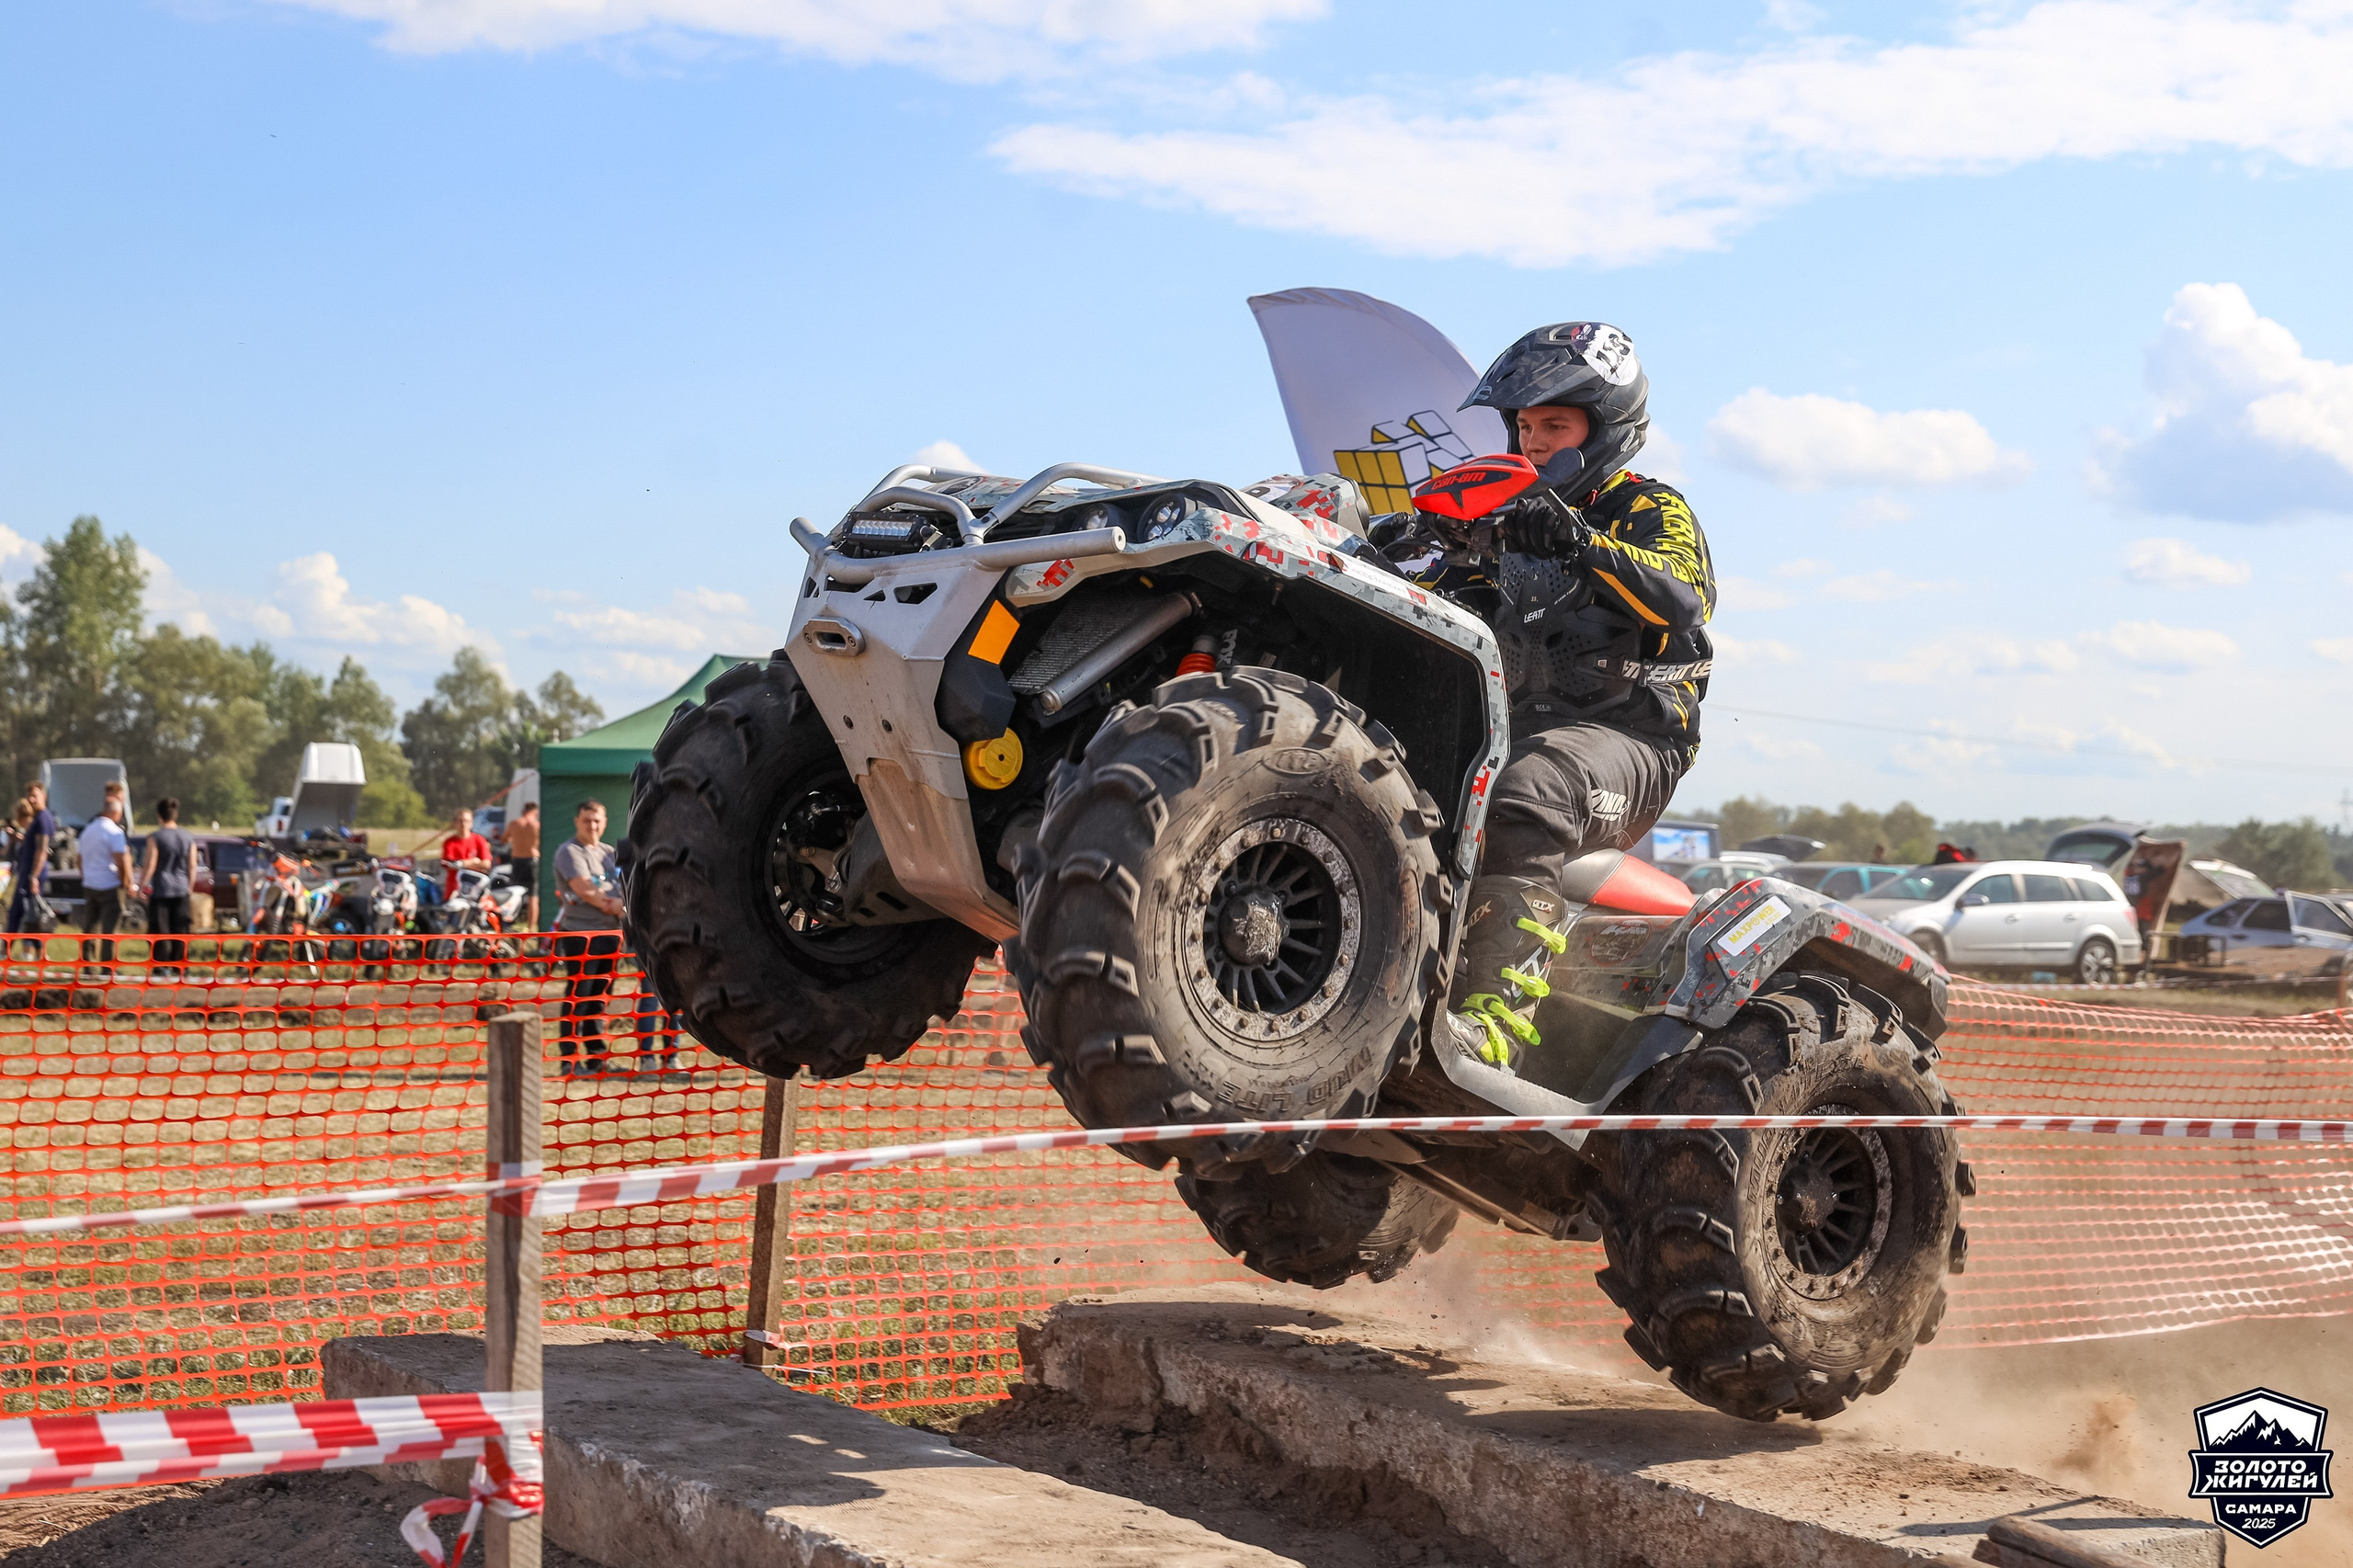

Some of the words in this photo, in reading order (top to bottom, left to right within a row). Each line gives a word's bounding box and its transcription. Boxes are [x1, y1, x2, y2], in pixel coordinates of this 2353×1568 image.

[1431, 472, 1487, 491] can-am
[1524, 608, 1546, 623] LEATT
[1728, 904, 1776, 944] MAXPOWER
[1217, 1081, 1292, 1112] LITE
